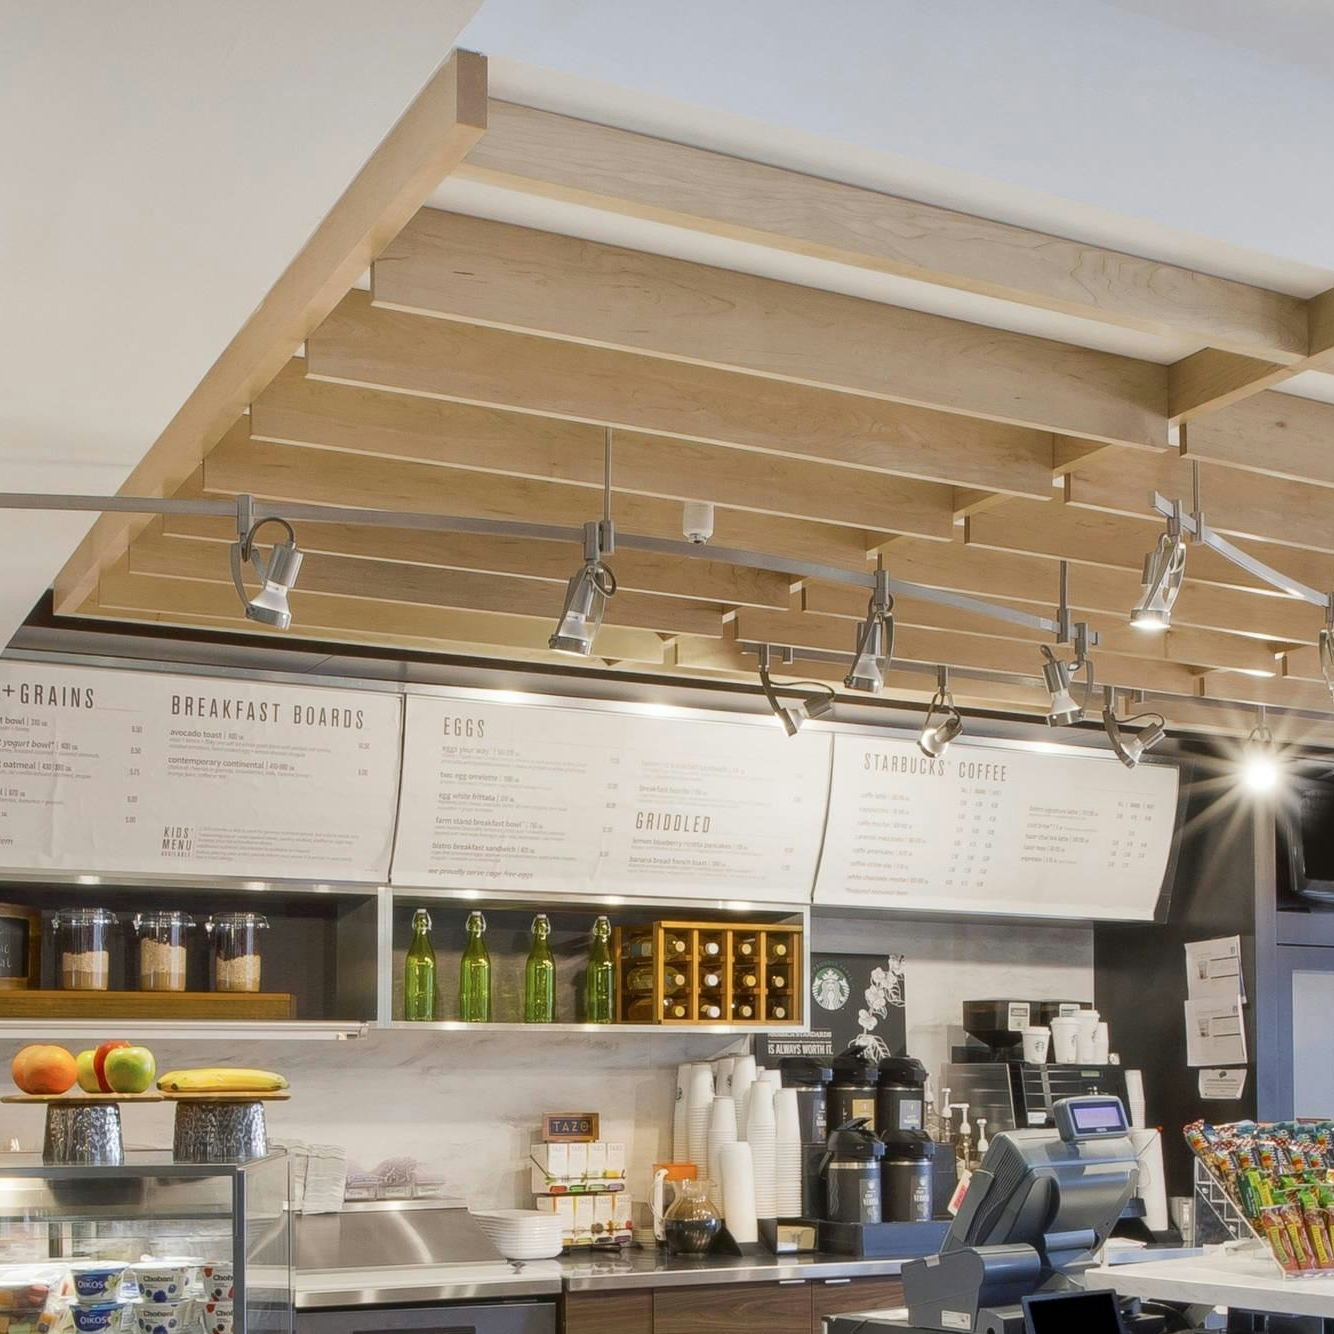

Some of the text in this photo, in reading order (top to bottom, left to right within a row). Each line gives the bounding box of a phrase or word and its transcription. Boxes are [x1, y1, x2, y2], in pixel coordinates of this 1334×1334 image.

[171, 695, 364, 730] BREAKFAST BOARDS
[5, 716, 25, 726] bowl
[443, 716, 485, 738] EGGS
[170, 729, 223, 740] avocado toast
[3, 738, 30, 749] yogurt
[3, 760, 37, 770] oatmeal
[958, 761, 1008, 782] COFFEE
[635, 811, 711, 833] GRIDDLED
[162, 839, 192, 851] MENU
[768, 1044, 775, 1055] IS
[775, 1044, 802, 1055] ALWAYS
[802, 1044, 824, 1055] WORTH
[552, 1121, 589, 1132] TAZO
[78, 1279, 104, 1289] OIKOS
[80, 1317, 107, 1325] OIKOS
